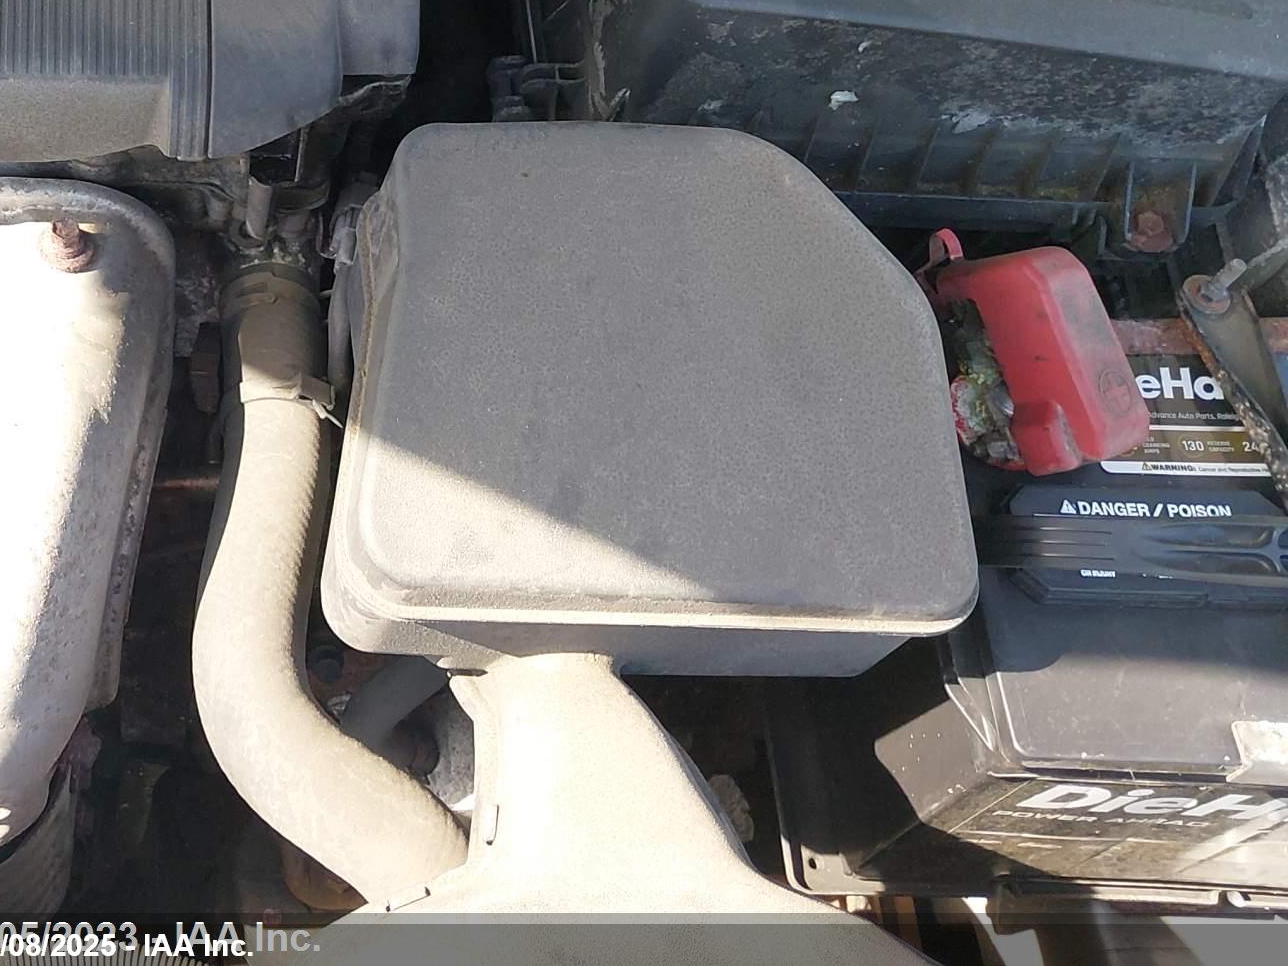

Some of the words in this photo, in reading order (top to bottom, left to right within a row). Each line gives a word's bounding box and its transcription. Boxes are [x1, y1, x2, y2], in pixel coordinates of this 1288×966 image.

[1182, 440, 1205, 452] 130
[1077, 500, 1151, 518] DANGER
[1153, 503, 1164, 518] /
[1167, 504, 1232, 518] POISON
